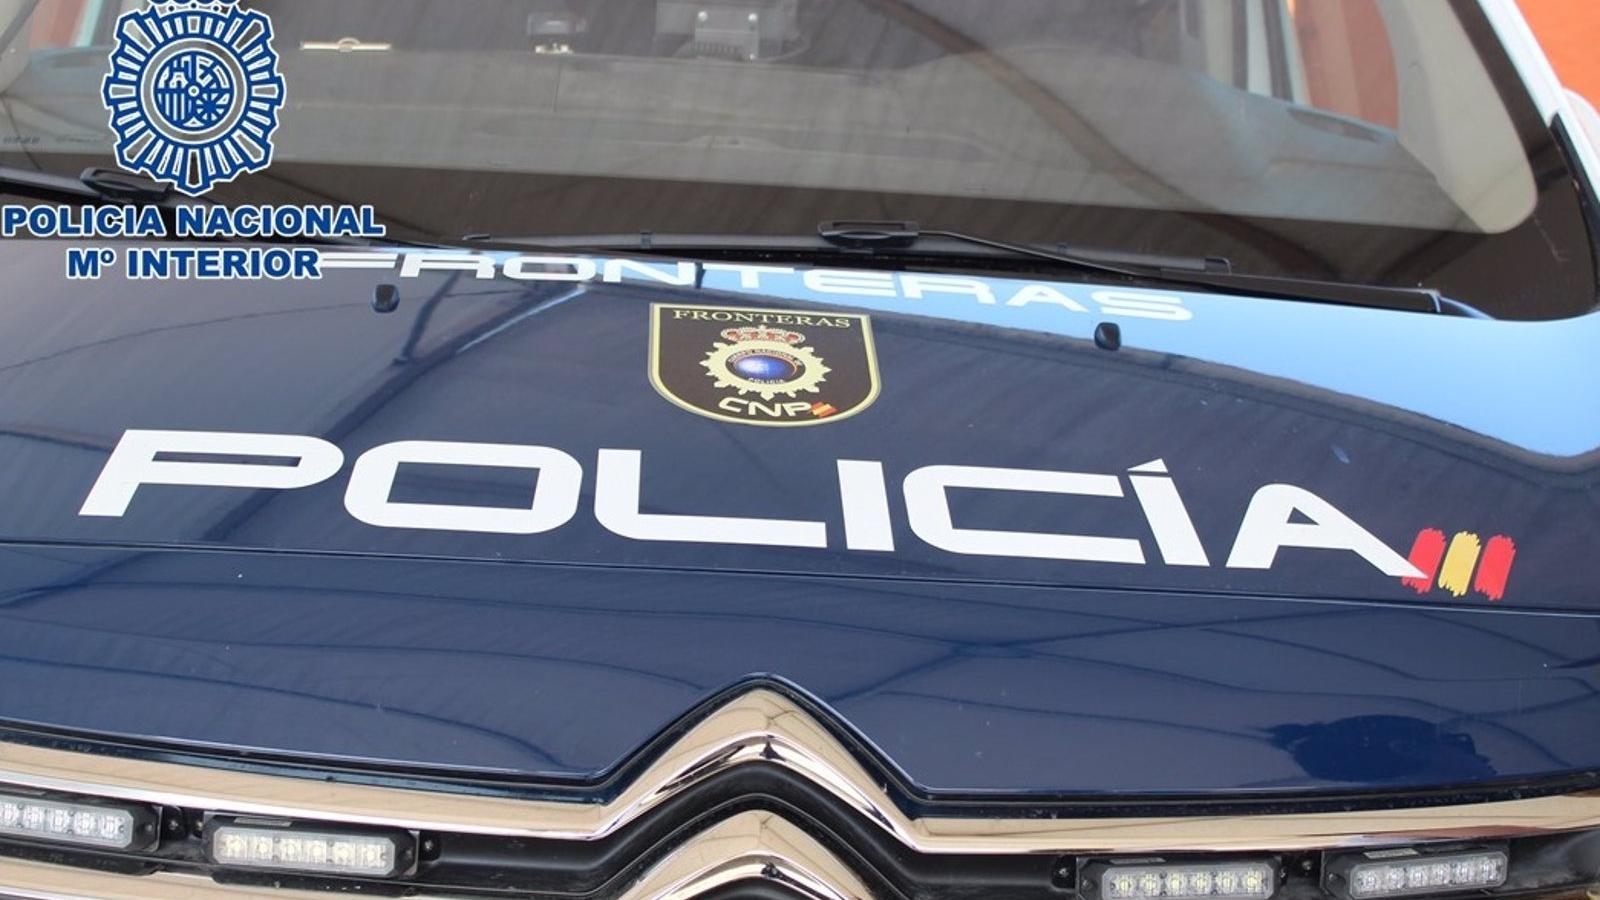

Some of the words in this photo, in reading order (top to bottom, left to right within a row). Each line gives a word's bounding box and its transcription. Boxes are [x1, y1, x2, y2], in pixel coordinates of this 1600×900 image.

[672, 309, 851, 329] FRONTERAS
[718, 396, 812, 417] CNP
[79, 429, 1428, 579] POLICÍA
